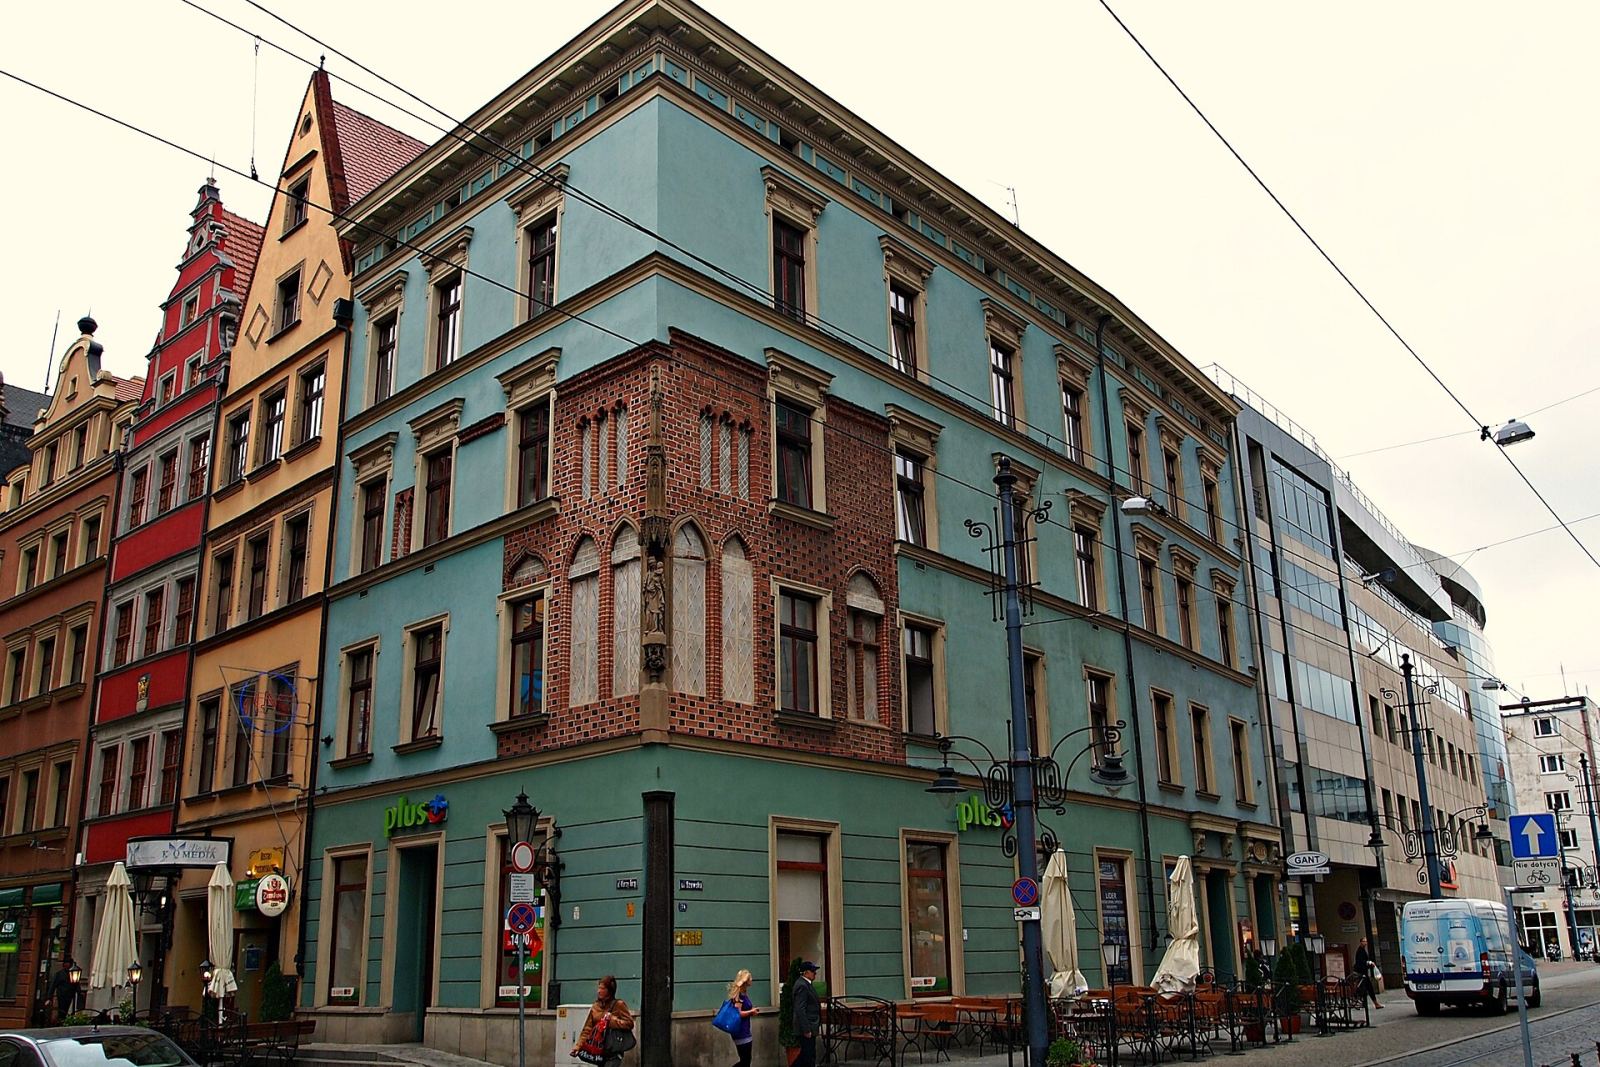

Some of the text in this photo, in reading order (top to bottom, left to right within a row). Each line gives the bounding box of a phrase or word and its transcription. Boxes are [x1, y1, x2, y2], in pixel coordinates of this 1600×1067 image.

[383, 794, 428, 838] plus
[957, 794, 1001, 831] plus
[1294, 855, 1320, 865] GANT
[1516, 861, 1558, 870] Nie dotyczy
